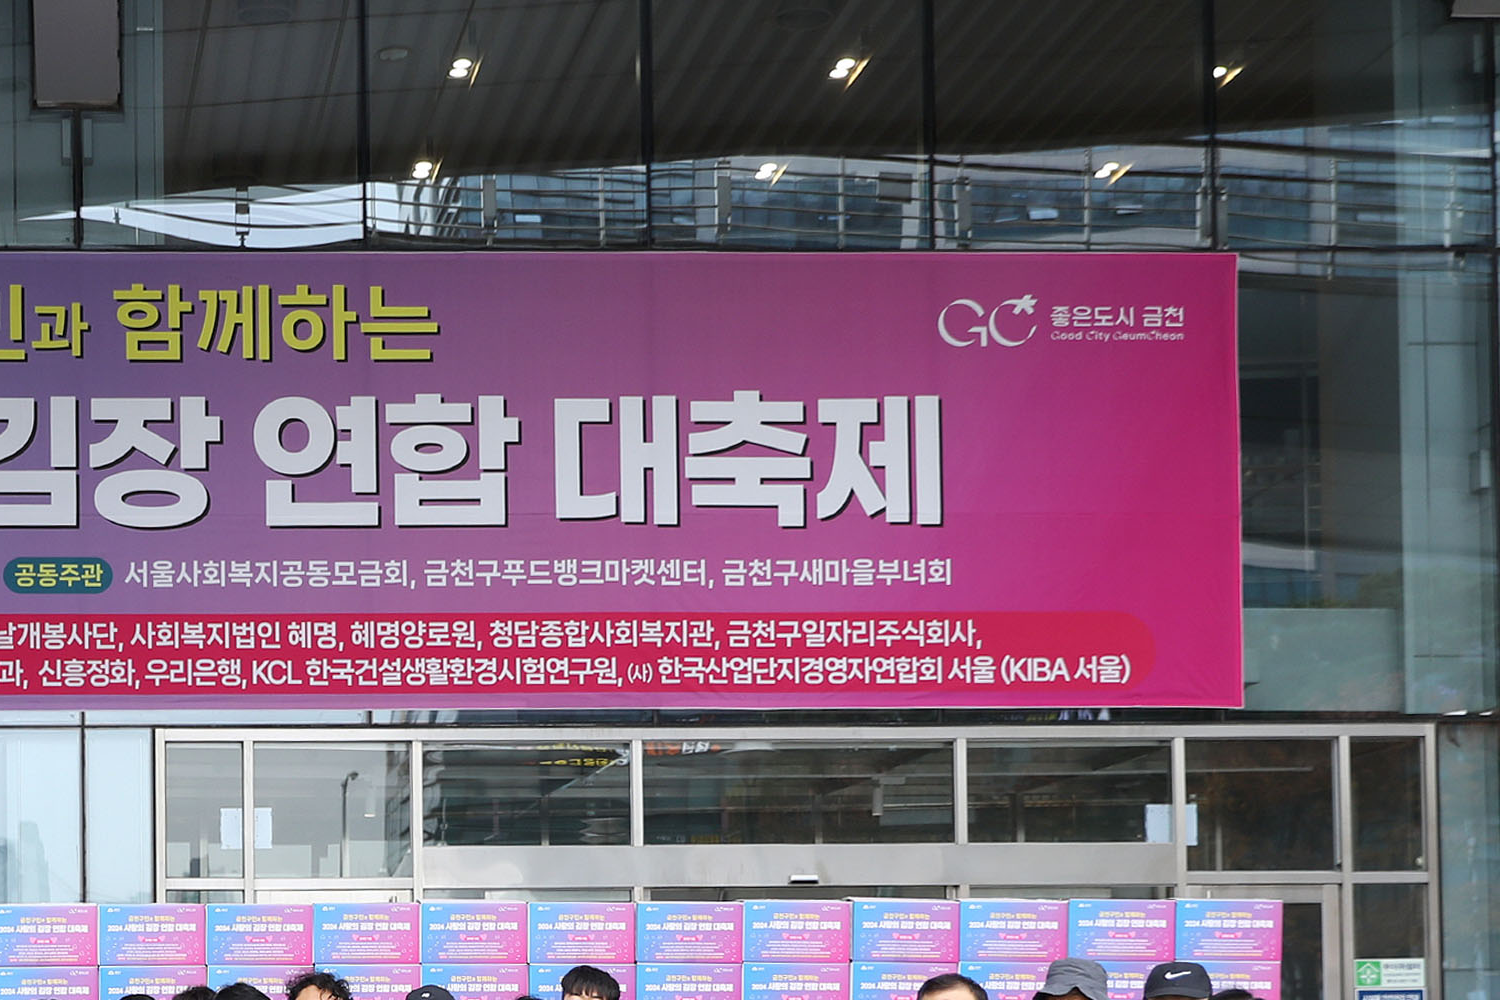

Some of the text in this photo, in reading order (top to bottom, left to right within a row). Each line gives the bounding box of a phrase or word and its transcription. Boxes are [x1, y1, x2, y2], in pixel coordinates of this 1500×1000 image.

[113, 283, 438, 361] 함께하는
[1050, 306, 1184, 327] 좋은도시 금천
[254, 394, 518, 527] 연합
[554, 391, 940, 527] 대축제
[15, 563, 103, 587] 공동주관
[124, 558, 952, 590] 서울사회복지공동모금회, 금천구푸드뱅크마켓센터, 금천구새마을부녀회
[130, 621, 281, 650] 사회복지법인
[287, 621, 344, 652] 혜명,
[350, 620, 483, 652] 혜명양로원,
[489, 619, 721, 651] 청담종합사회복지관,
[726, 619, 982, 650] 금천구일자리주식회사,
[38, 658, 141, 690] 신흥정화,
[144, 658, 248, 690] 우리은행,
[252, 660, 302, 685] KCL
[305, 656, 623, 688] 한국건설생활환경시험연구원,
[627, 662, 653, 684] (사)
[657, 655, 943, 685] 한국산업단지경영자연합회
[947, 655, 997, 684] 서울
[1000, 655, 1071, 685] (KIBA
[1074, 654, 1131, 685] 서울)
